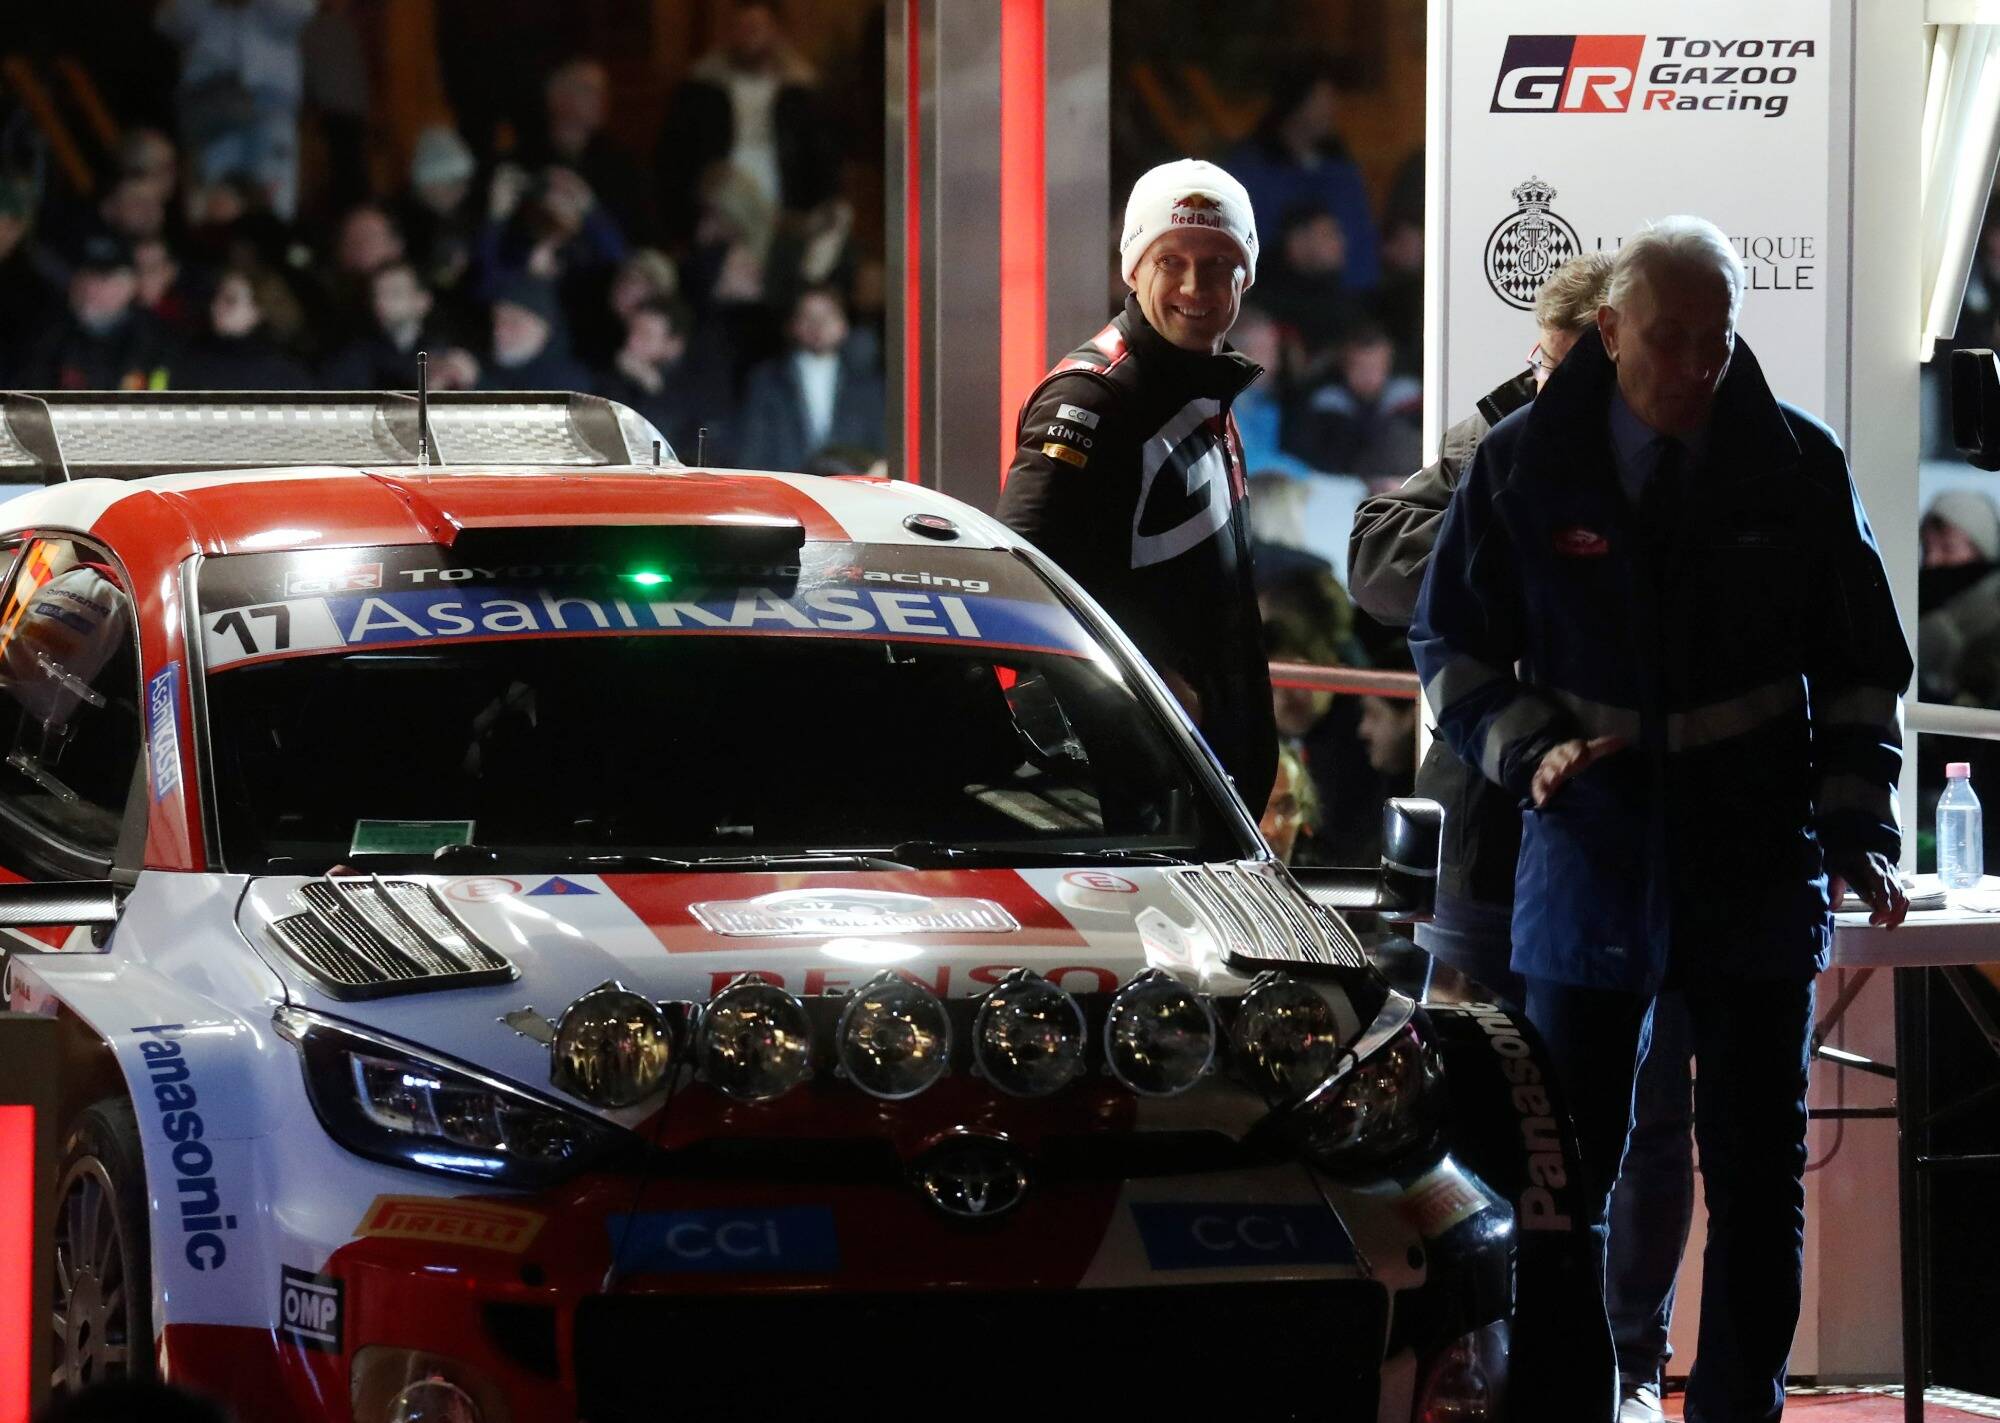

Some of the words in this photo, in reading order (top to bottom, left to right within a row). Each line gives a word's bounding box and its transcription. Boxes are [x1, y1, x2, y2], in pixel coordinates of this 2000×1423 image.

[1656, 36, 1815, 59] TOYOTA
[1497, 66, 1632, 110] GR
[1648, 63, 1797, 85] GAZOO
[1643, 90, 1788, 118] Racing
[1171, 212, 1197, 226] Red
[1197, 214, 1221, 229] Bull
[1744, 266, 1814, 290] LLE
[212, 603, 290, 655] 17
[1455, 1001, 1573, 1229] Panasonic
[131, 1022, 238, 1272] Panasonic
[370, 1200, 530, 1243] PIRELLI
[284, 1287, 337, 1330] OMP
